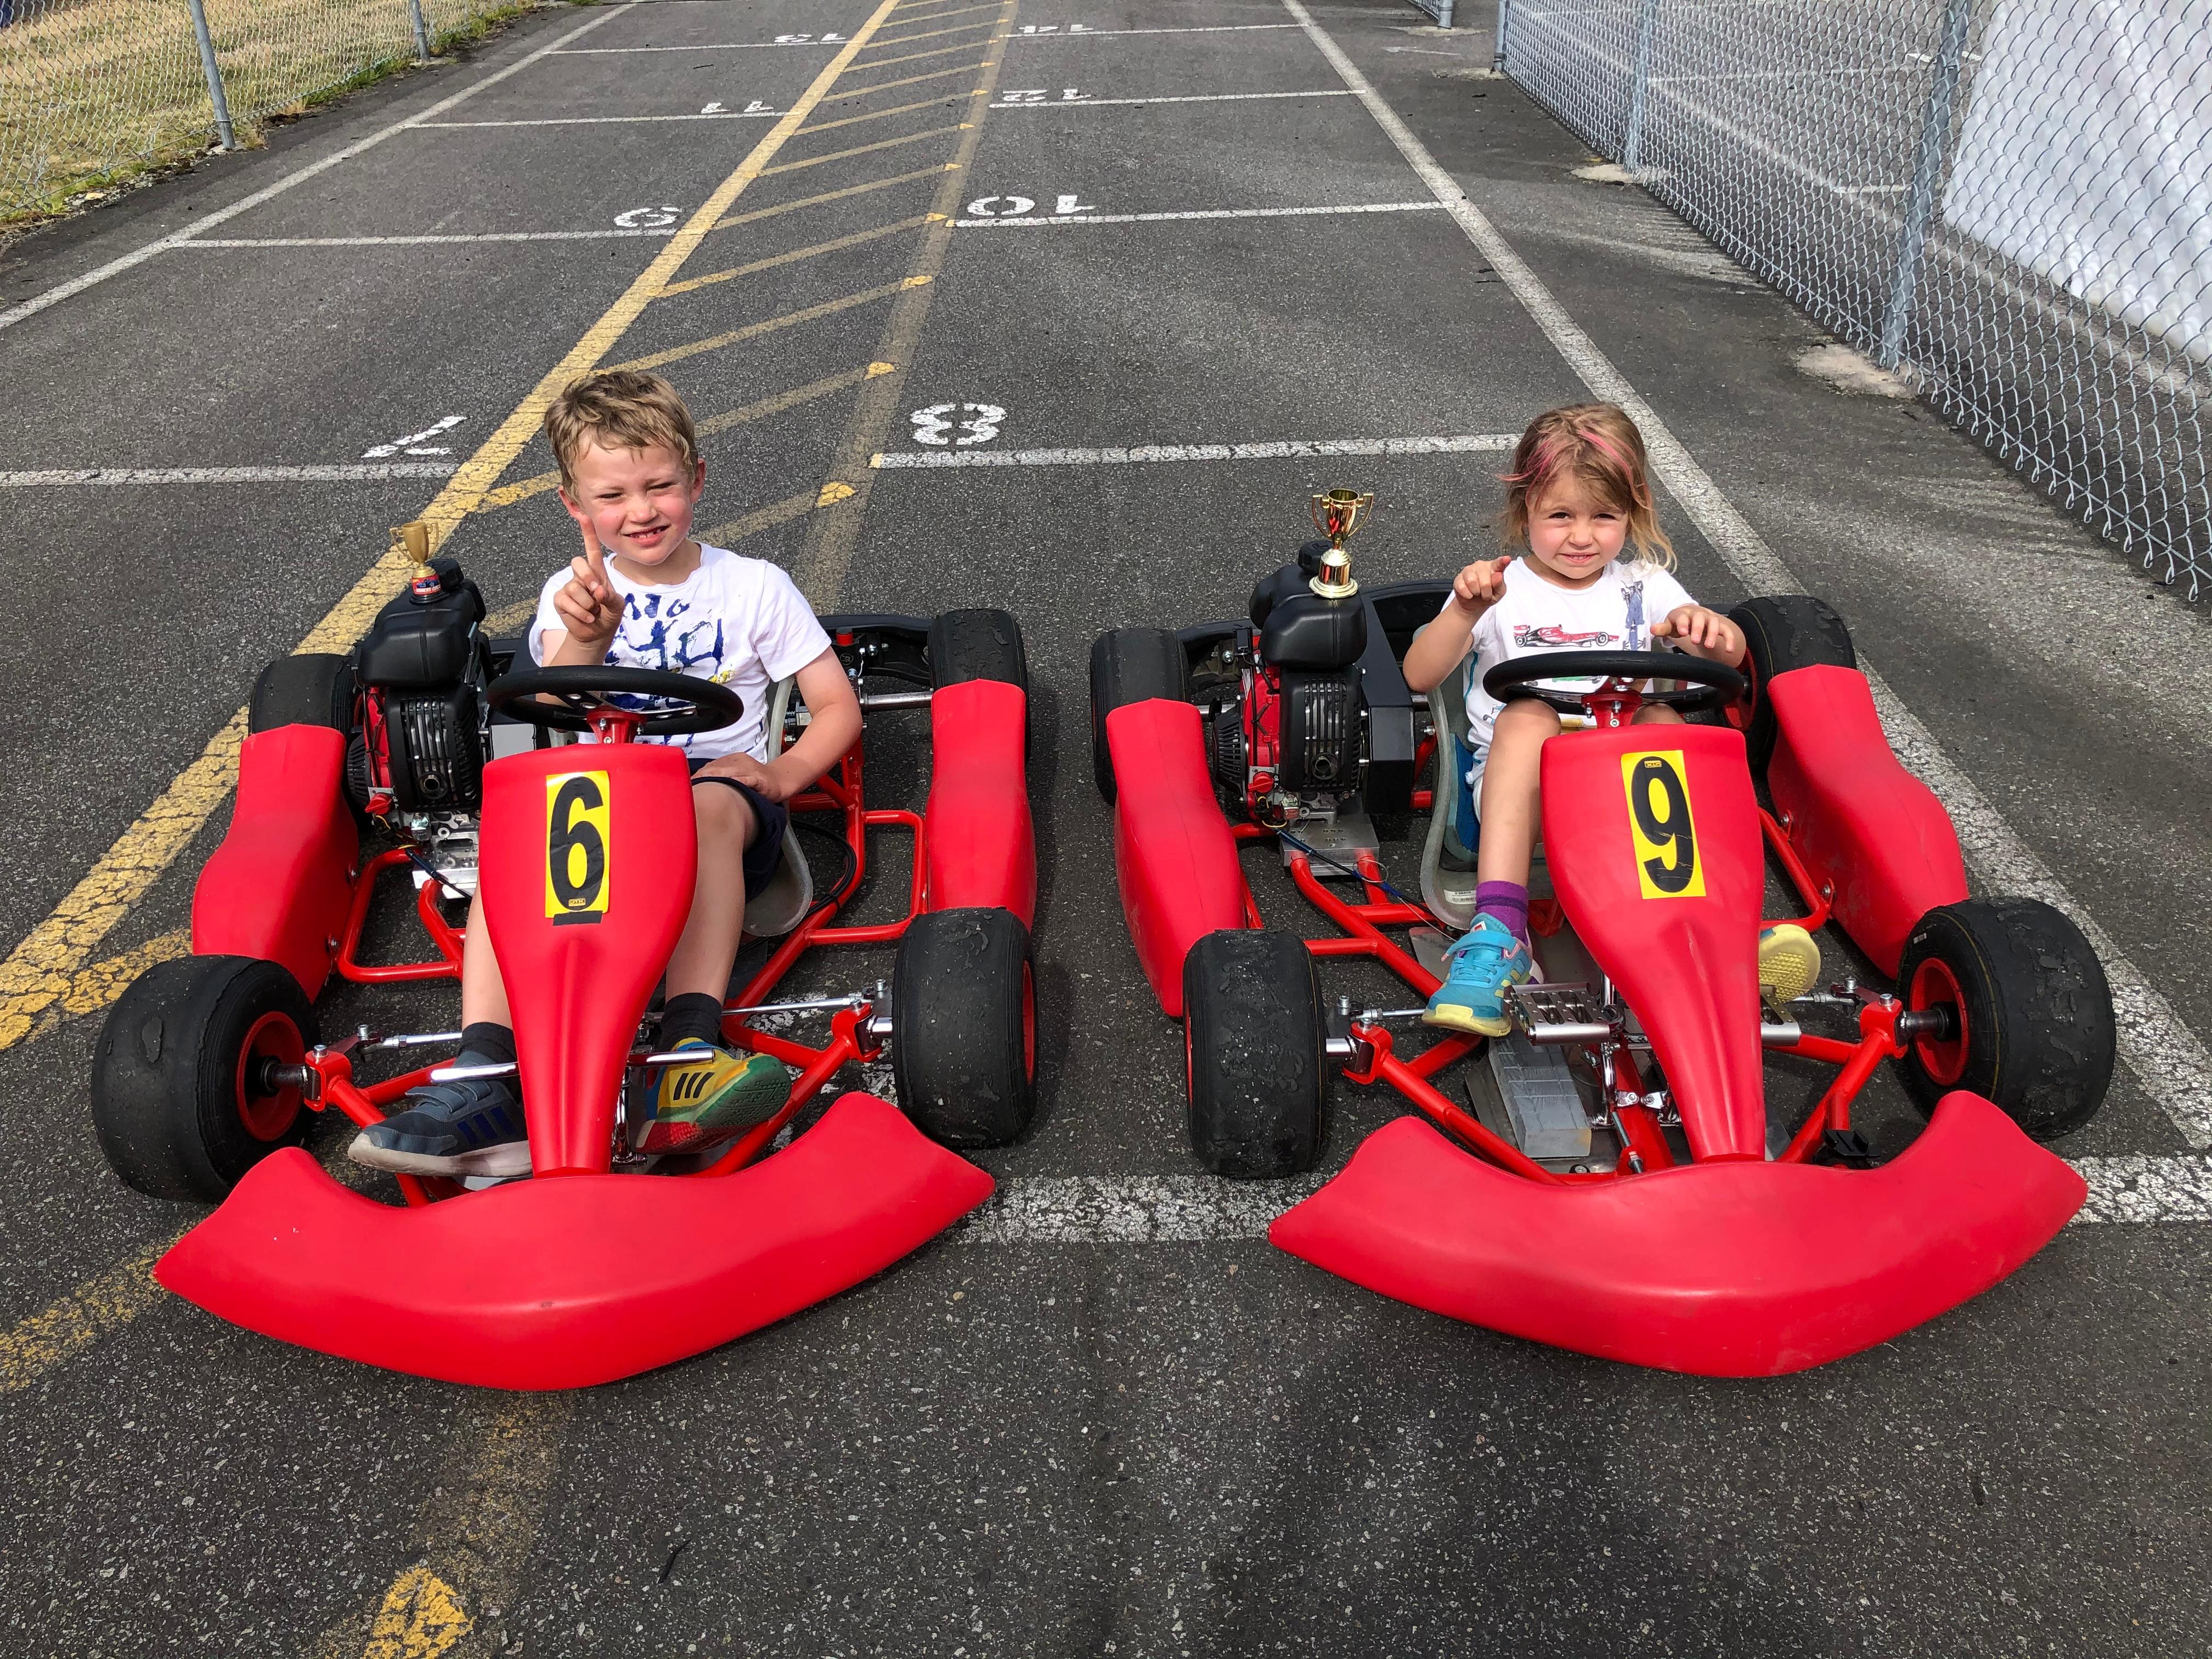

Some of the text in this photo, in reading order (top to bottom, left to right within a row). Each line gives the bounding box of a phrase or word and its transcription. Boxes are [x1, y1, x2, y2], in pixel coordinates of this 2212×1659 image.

[1002, 89, 1092, 101] 12
[966, 194, 1097, 217] 10
[361, 416, 467, 458] 7
[909, 402, 1007, 446] 8
[549, 776, 604, 911] 6
[1631, 756, 1694, 893] 9
